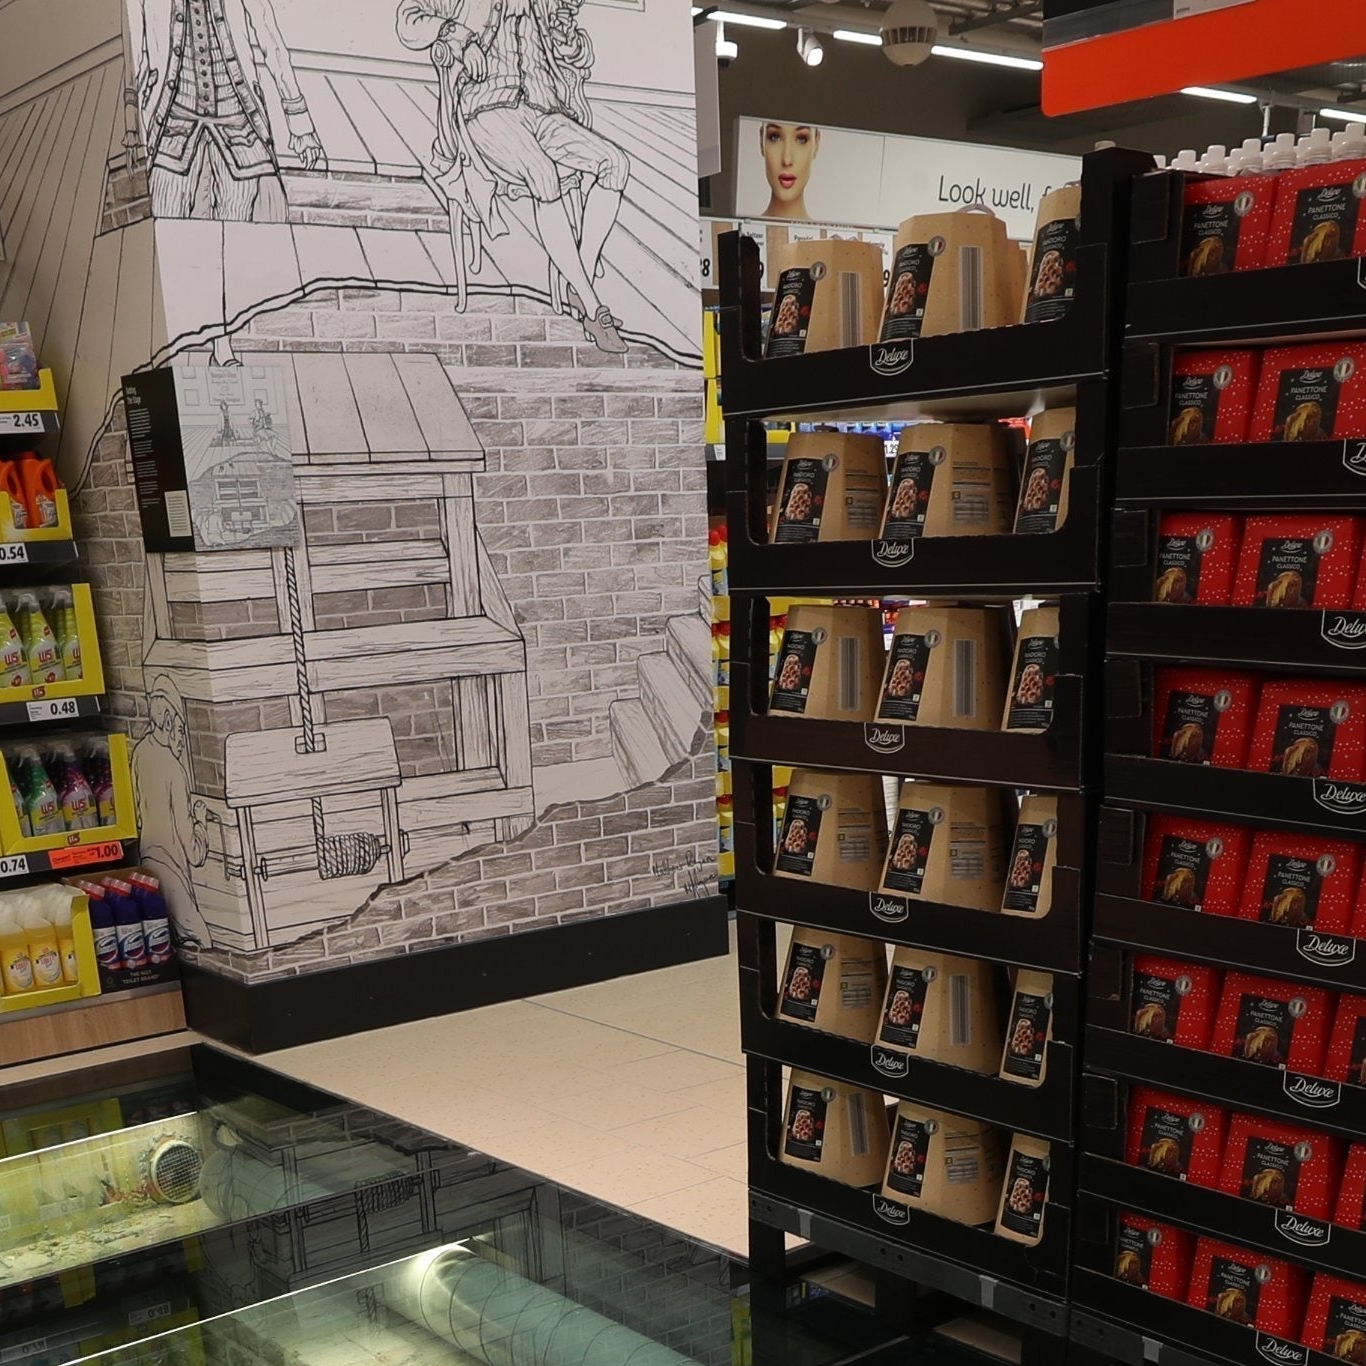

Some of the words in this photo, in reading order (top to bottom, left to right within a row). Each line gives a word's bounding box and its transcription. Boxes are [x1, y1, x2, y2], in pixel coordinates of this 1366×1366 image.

[939, 176, 984, 203] Look
[992, 183, 1034, 213] well,
[877, 345, 909, 367] Deluxe
[13, 412, 39, 428] 2.45
[877, 540, 909, 560] Deluxe
[50, 700, 76, 716] 0.48
[0, 857, 25, 872] 0.74
[874, 899, 904, 915] Deluxe
[1303, 935, 1349, 959] Deluxe
